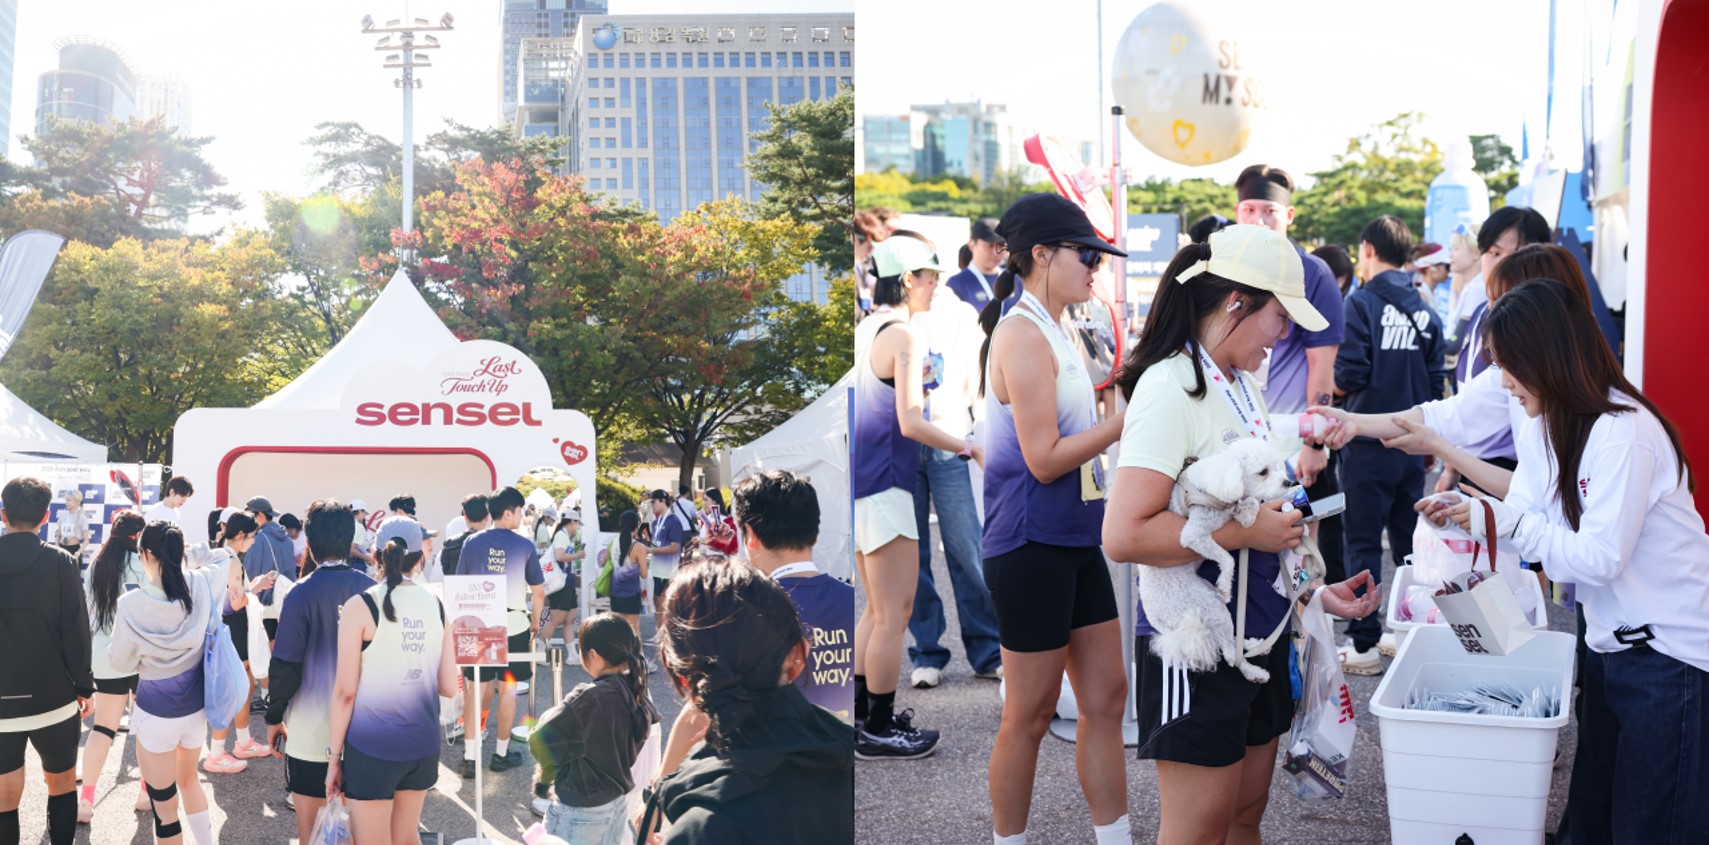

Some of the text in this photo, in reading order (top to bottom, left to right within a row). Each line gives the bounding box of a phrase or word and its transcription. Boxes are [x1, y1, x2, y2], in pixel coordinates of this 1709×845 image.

[473, 355, 522, 378] Last
[355, 401, 543, 427] sensel
[490, 547, 505, 557] Run
[487, 556, 506, 565] your
[402, 617, 424, 629] Run
[1450, 623, 1482, 638] sen
[401, 631, 426, 643] your
[812, 627, 848, 646] Run
[401, 643, 426, 655] way.
[1460, 638, 1489, 654] sel
[811, 648, 853, 671] your
[811, 668, 853, 687] way.
